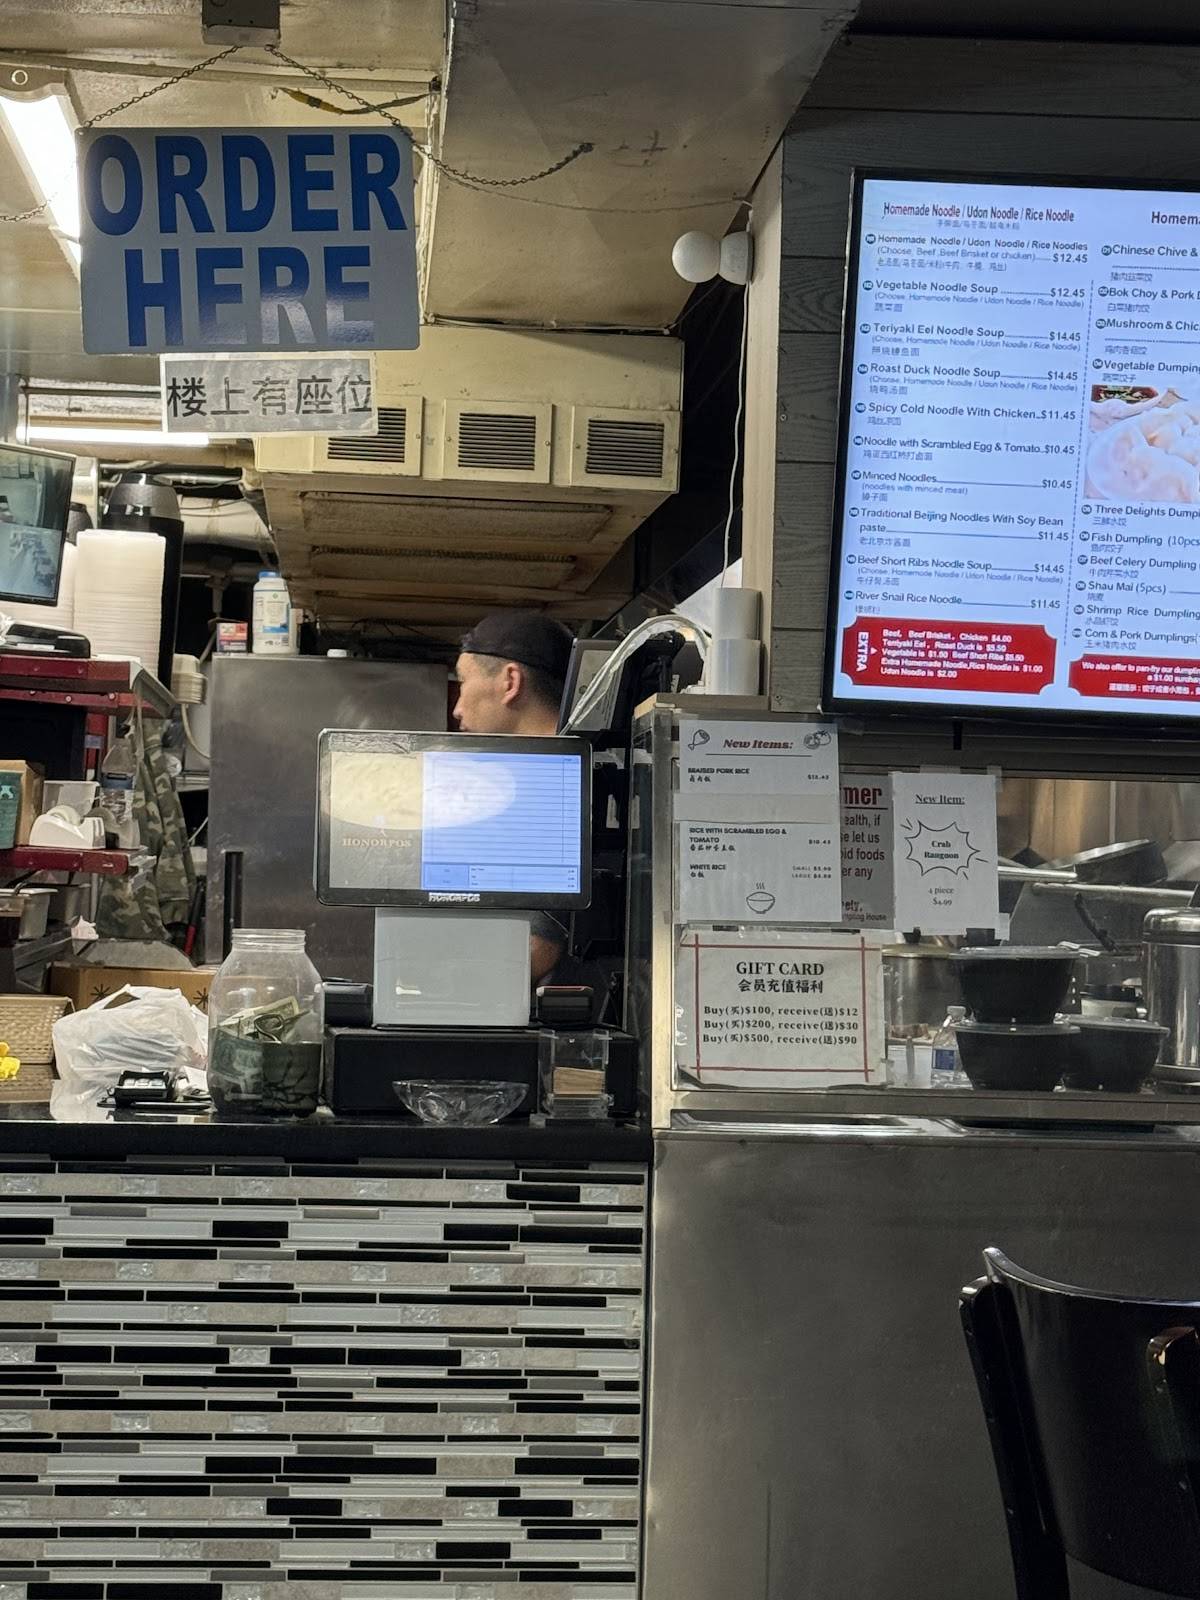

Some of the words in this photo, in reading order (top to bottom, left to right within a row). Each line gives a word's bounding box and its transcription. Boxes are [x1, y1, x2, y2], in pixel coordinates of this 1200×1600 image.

[84, 134, 407, 235] ORDER
[884, 202, 929, 216] Homemade
[932, 204, 960, 217] Noodle
[967, 206, 988, 218] Udon
[991, 207, 1018, 219] Noodle
[1025, 208, 1043, 221] Rice
[1046, 209, 1074, 222] Noodle
[1032, 240, 1050, 249] Rice
[1052, 242, 1087, 251] Noodles
[1112, 244, 1154, 256] Chinese
[1157, 246, 1187, 256] Chive
[1190, 247, 1198, 257] &
[1053, 252, 1088, 263] $12.45
[124, 245, 376, 347] HERE
[875, 280, 927, 292] Vegetable
[931, 282, 967, 293] Noodle
[970, 285, 998, 296] Soup
[1050, 287, 1085, 298] $12.45
[1109, 288, 1128, 297] Bok
[1131, 289, 1158, 300] Choy
[1160, 290, 1168, 298] &
[1171, 290, 1195, 299] Pork
[1106, 318, 1163, 329] Mushroom
[1165, 321, 1173, 329] &
[1175, 321, 1200, 331] Chic
[873, 323, 915, 335] Teriyaki
[918, 324, 934, 334] Eel
[937, 325, 973, 336] Noodle
[976, 328, 1004, 339] Soup
[1049, 332, 1080, 342] $14.45
[871, 363, 900, 374] Roast
[903, 364, 930, 375] Duck
[933, 366, 970, 376] Noodle
[973, 368, 1000, 379] Soup
[1048, 371, 1078, 381] $14.45
[1104, 360, 1154, 371] Vegetable
[1158, 362, 1200, 374] Dumpin
[166, 375, 372, 418] 楼上有座位
[868, 402, 897, 415] Spicy
[900, 403, 924, 414] Cold
[927, 405, 963, 416] Noodle
[967, 407, 990, 418] With
[993, 408, 1035, 420] Chicken
[1041, 410, 1075, 421] $11.45
[863, 437, 897, 446] Noodle
[899, 438, 918, 448] with
[920, 439, 971, 450] Scrambled
[973, 441, 991, 453] Egg
[994, 442, 1001, 451] &
[1005, 443, 1040, 453] Tomato
[1044, 444, 1074, 454] $10.45
[862, 471, 896, 481] Minced
[898, 472, 936, 482] Noodles
[1041, 479, 1071, 489] $10.45
[860, 508, 911, 519] Traditional
[914, 510, 947, 522] Beijing
[950, 512, 989, 523] Noodles
[992, 514, 1014, 524] With
[1017, 515, 1036, 526] Soy
[1039, 516, 1064, 526] Bean
[1096, 505, 1123, 514] Three
[1125, 506, 1165, 518] Delights
[859, 524, 886, 534] paste
[1038, 531, 1069, 541] $11.45
[1092, 532, 1112, 542] Fish
[1115, 533, 1162, 546] Dumpling
[857, 555, 879, 564] Beef
[881, 556, 905, 566] Short
[908, 557, 929, 567] Ribs
[931, 559, 965, 569] Noodle
[967, 561, 992, 571] Soup
[1034, 564, 1064, 574] $14.45
[1090, 556, 1113, 565] Beef
[1115, 557, 1146, 569] Celery
[1149, 558, 1196, 571] Dumpling
[1088, 581, 1113, 591] Shau
[1136, 583, 1166, 595] (5pcs)
[855, 591, 880, 601] River
[882, 592, 905, 602] Snail
[907, 593, 928, 603] Rice
[929, 595, 962, 605] Noodle
[1031, 599, 1060, 609] $11.45
[1086, 605, 1122, 616] Shrimp
[1127, 607, 1149, 616] Rice
[1110, 630, 1118, 638] &
[1120, 630, 1141, 639] Pork
[857, 631, 869, 672] EXTRA
[723, 739, 749, 748] New
[752, 740, 794, 749] Items:
[844, 786, 882, 805] mer
[916, 794, 936, 804] New
[940, 794, 965, 804] Item:
[845, 814, 870, 828] ealth,
[874, 814, 881, 826] if
[852, 831, 866, 843] let
[868, 834, 880, 843] us
[931, 841, 951, 849] Crab
[856, 848, 885, 861] foods
[924, 851, 959, 860] Rangoon
[855, 867, 872, 881] any
[736, 961, 775, 975] GIFT
[778, 962, 824, 976] CARD
[738, 979, 823, 994] 会员充值福利
